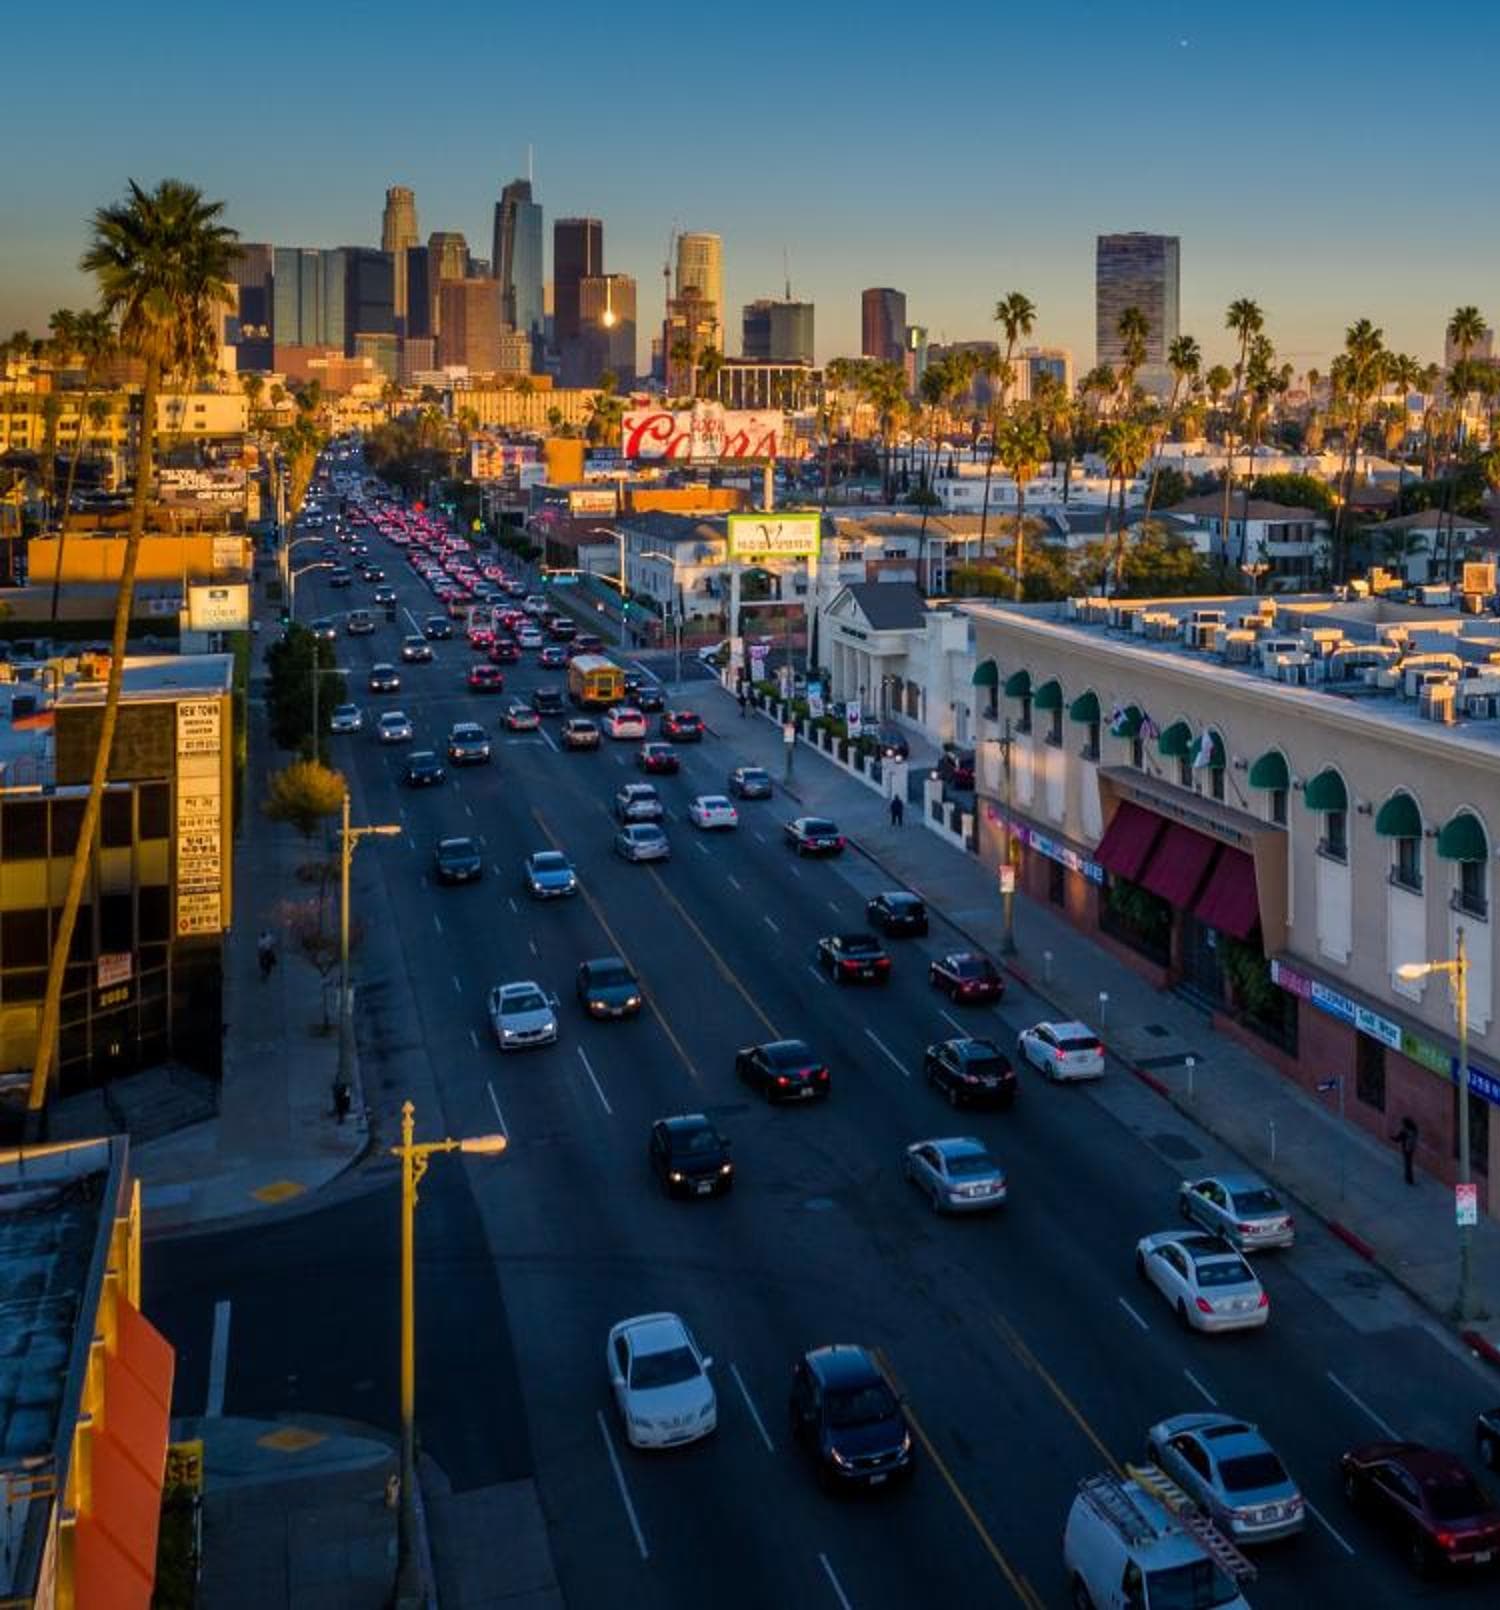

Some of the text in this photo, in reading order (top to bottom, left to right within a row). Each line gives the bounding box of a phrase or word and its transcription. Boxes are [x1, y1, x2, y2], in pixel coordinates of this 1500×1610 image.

[623, 413, 777, 463] Cors
[180, 705, 219, 716] NEW TOWN
